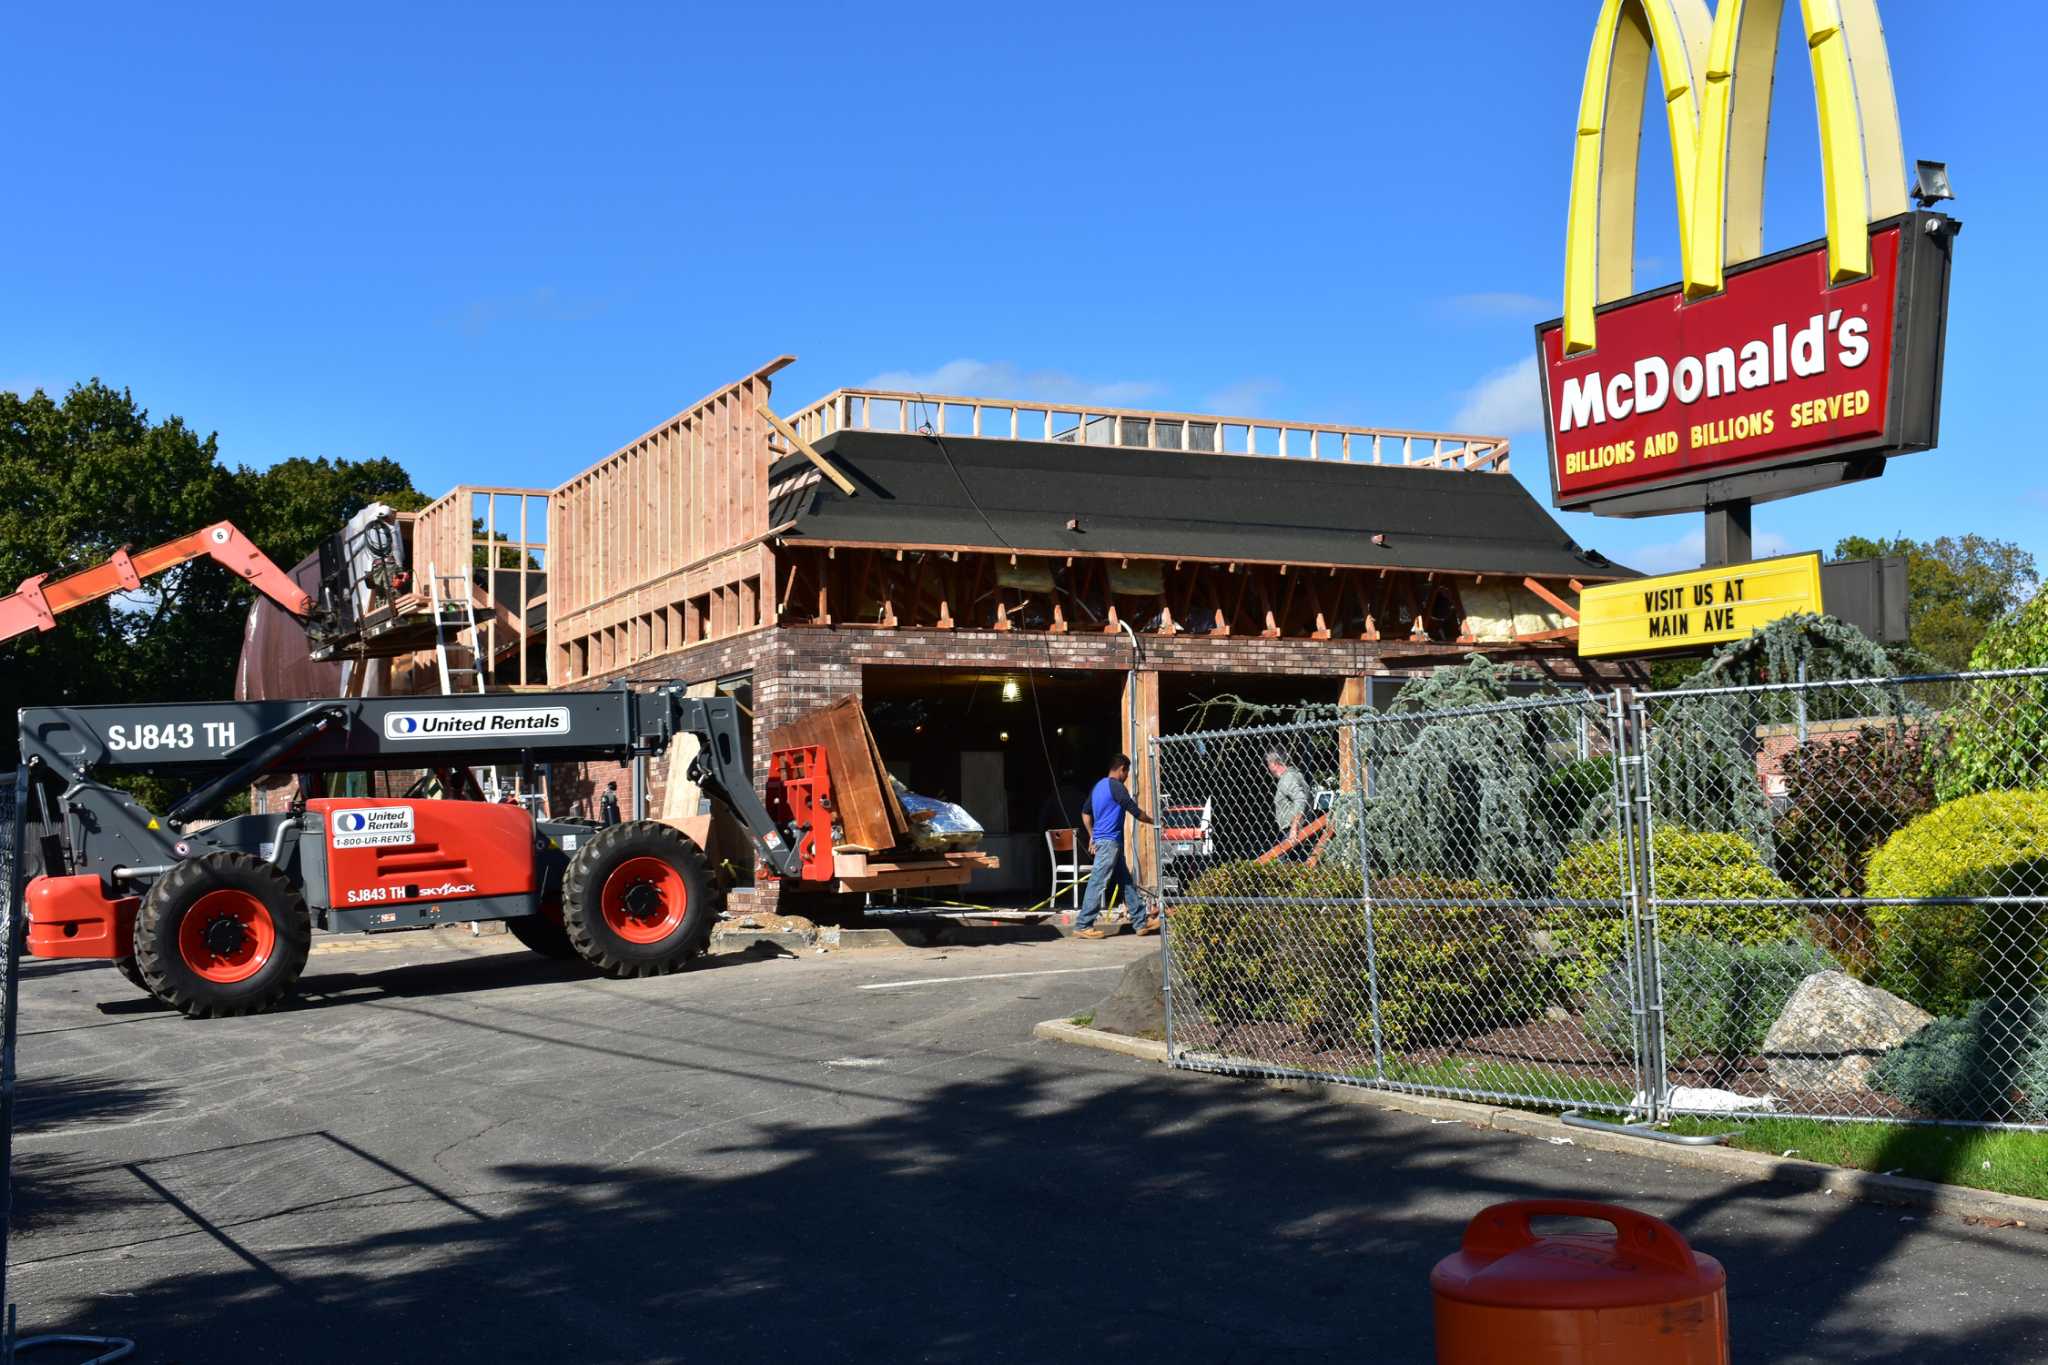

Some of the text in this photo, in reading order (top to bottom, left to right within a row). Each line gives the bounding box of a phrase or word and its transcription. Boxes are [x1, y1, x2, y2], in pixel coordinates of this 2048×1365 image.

[1560, 308, 1869, 432] McDonald's
[1566, 389, 1870, 475] BILLIONS AND BILLIONS SERVED
[1644, 578, 1744, 613] VISIT US AT
[1649, 607, 1735, 638] MAIN AVE
[422, 712, 561, 733] United Rentals
[108, 721, 236, 751] SJ843 TH
[368, 811, 405, 821] United
[368, 819, 408, 830] Rentals
[336, 834, 412, 846] 1-800-UR-RENTS
[347, 885, 406, 903] SJ843 TH
[419, 882, 476, 896] SKYJACK
